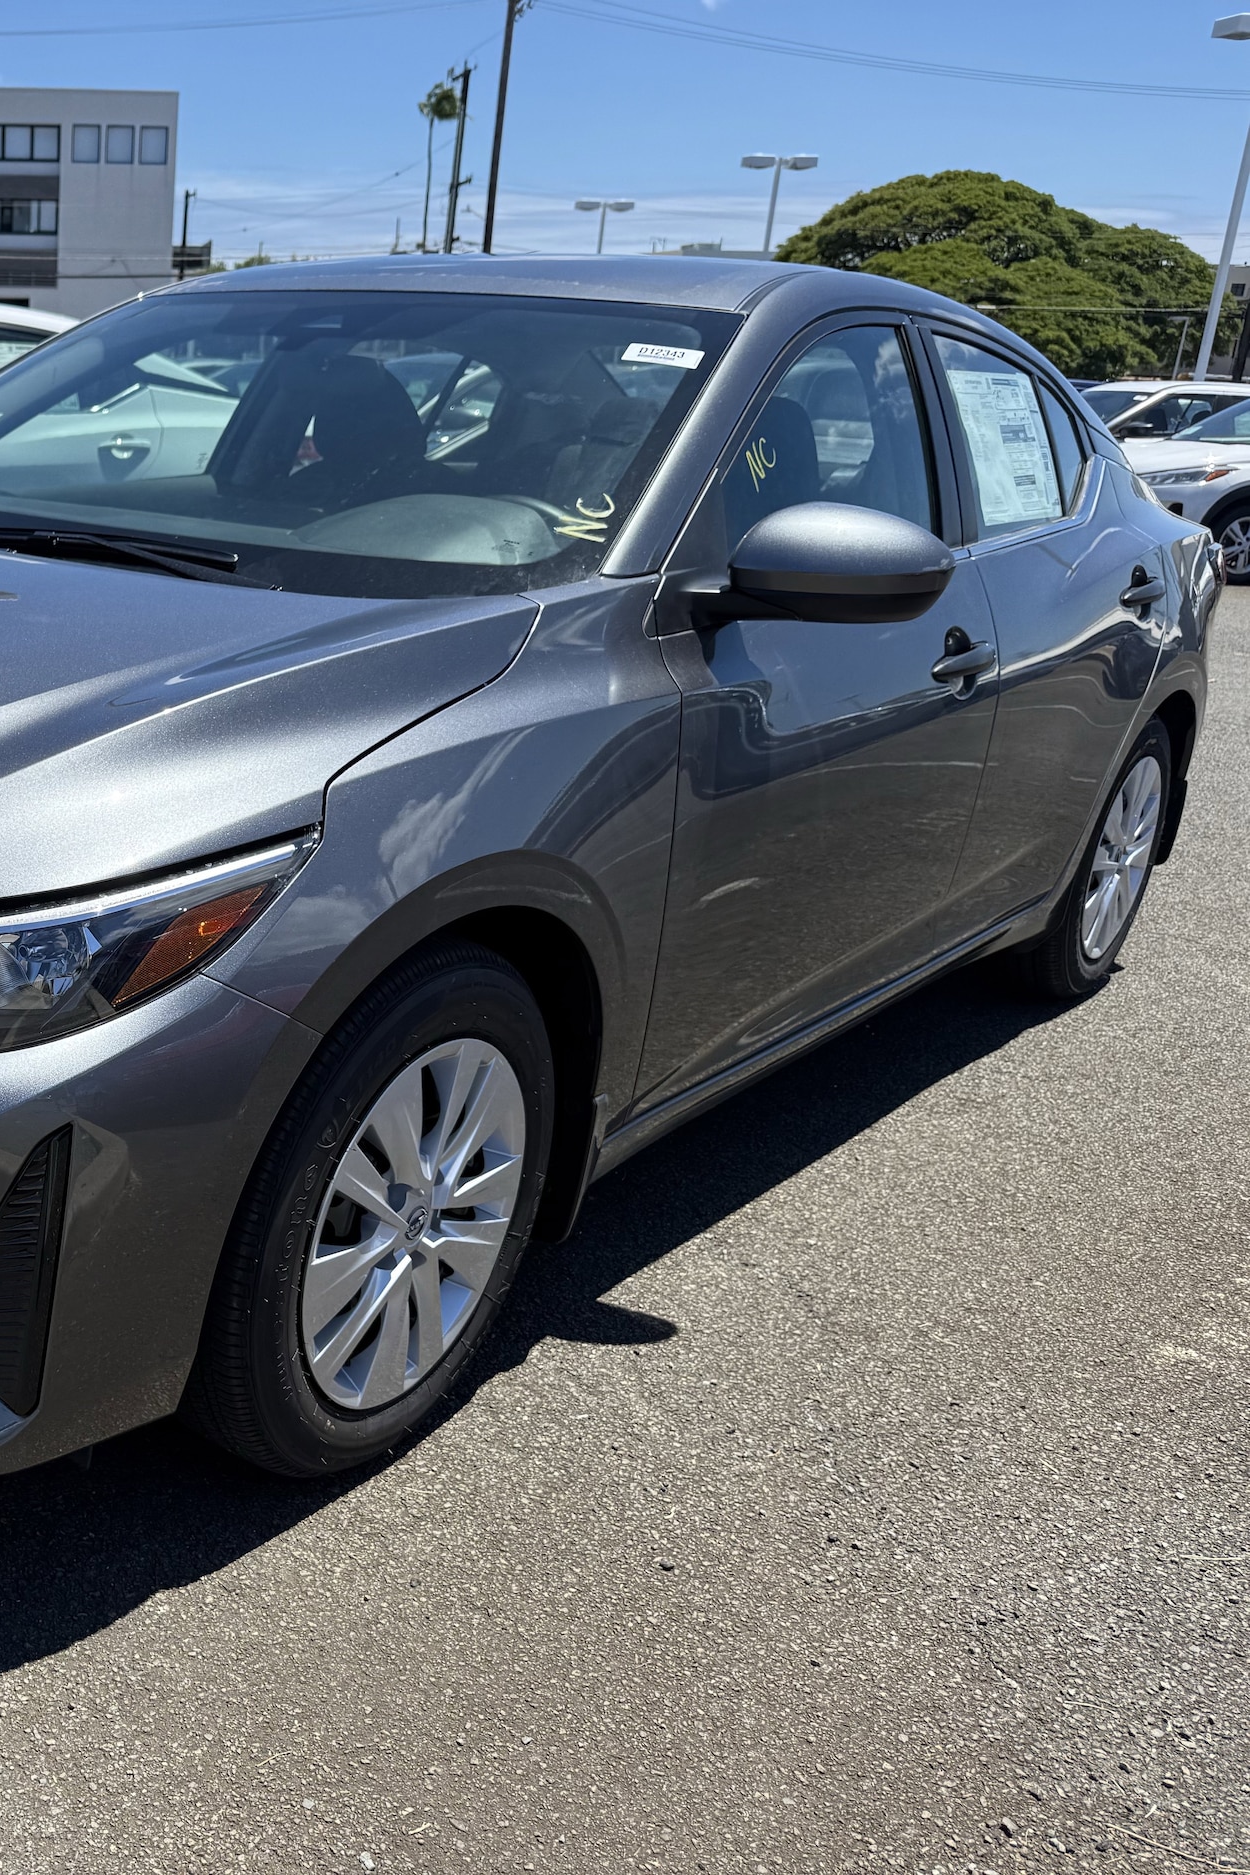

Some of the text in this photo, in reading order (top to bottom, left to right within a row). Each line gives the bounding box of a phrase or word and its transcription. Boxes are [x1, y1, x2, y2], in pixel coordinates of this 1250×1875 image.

[638, 346, 685, 359] D12343
[746, 437, 776, 493] NC
[553, 492, 616, 543] NC
